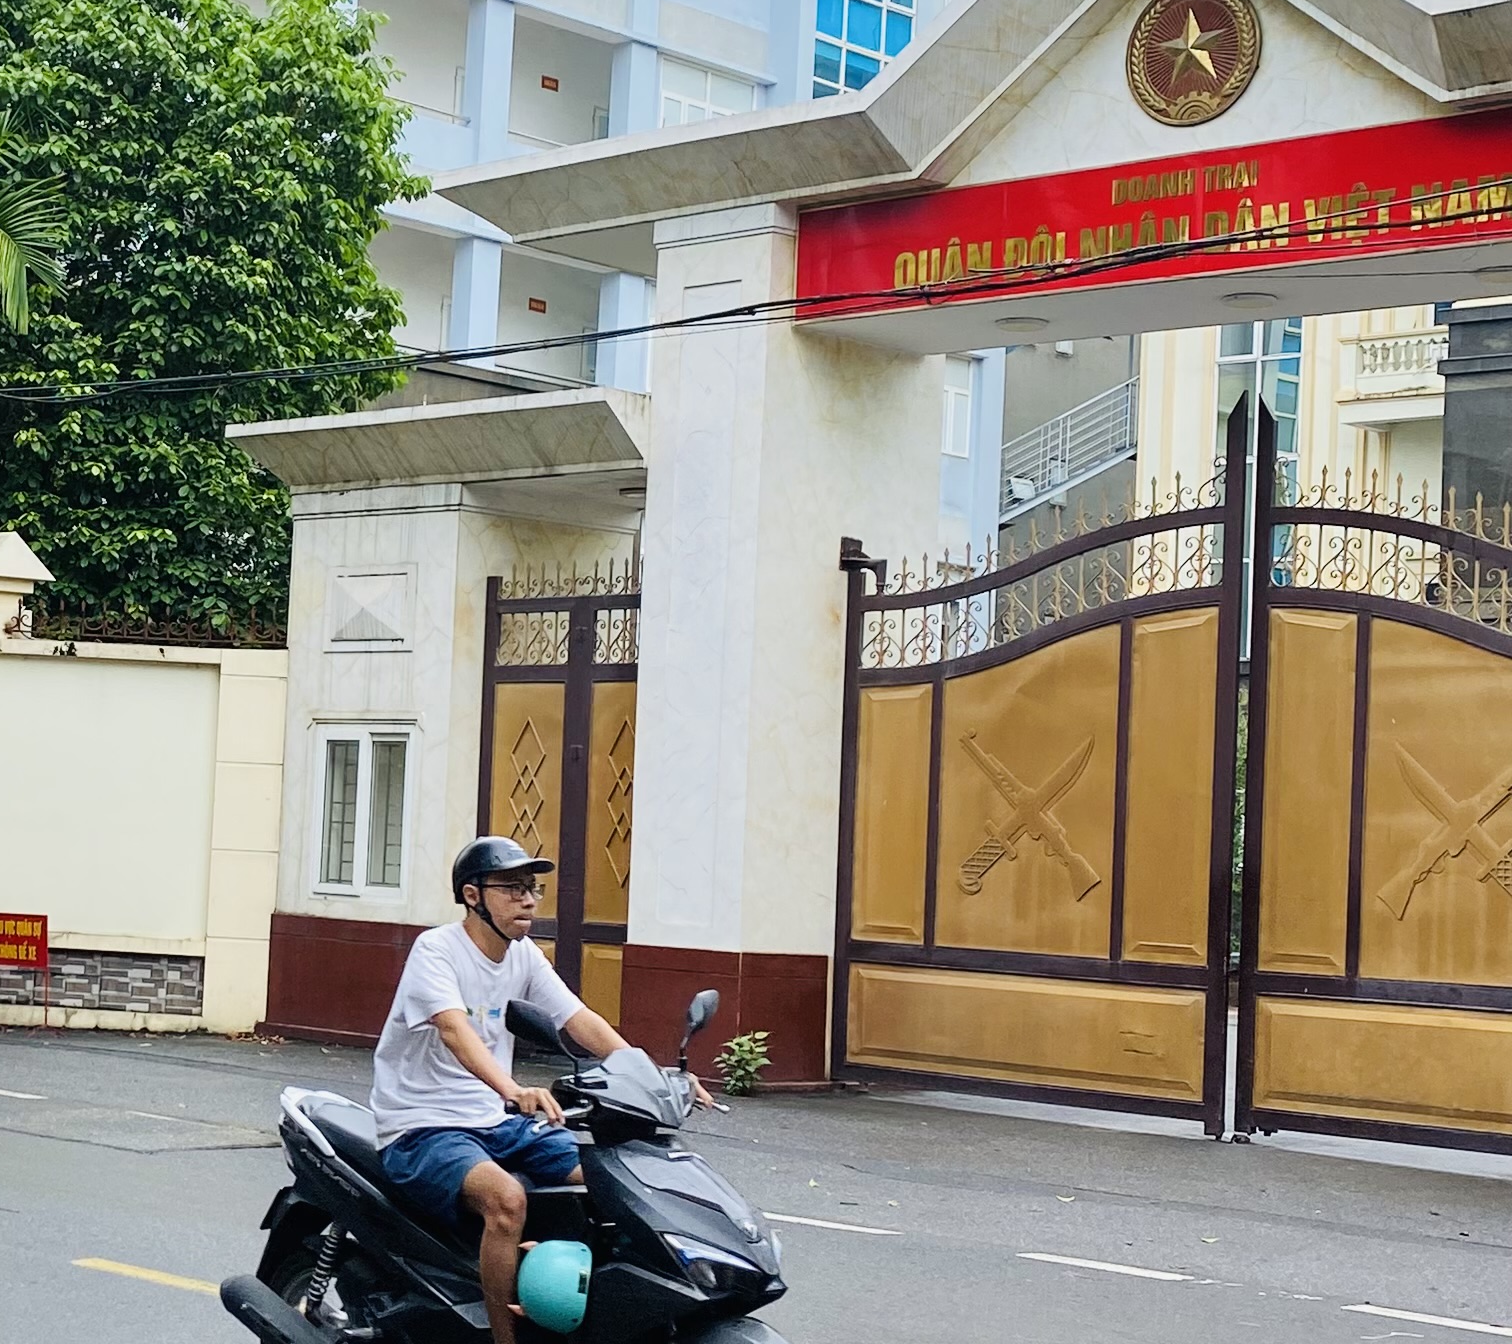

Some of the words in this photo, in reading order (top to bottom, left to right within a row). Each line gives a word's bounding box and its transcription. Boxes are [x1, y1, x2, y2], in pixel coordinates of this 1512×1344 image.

[1112, 169, 1195, 206] DOANH
[1203, 160, 1259, 192] TRẠI
[894, 237, 992, 289] QUÂN
[1080, 211, 1190, 262] NHÂN
[1203, 198, 1290, 253] DÂN
[1304, 182, 1396, 245] VIỆT
[1410, 172, 1512, 231] NAM
